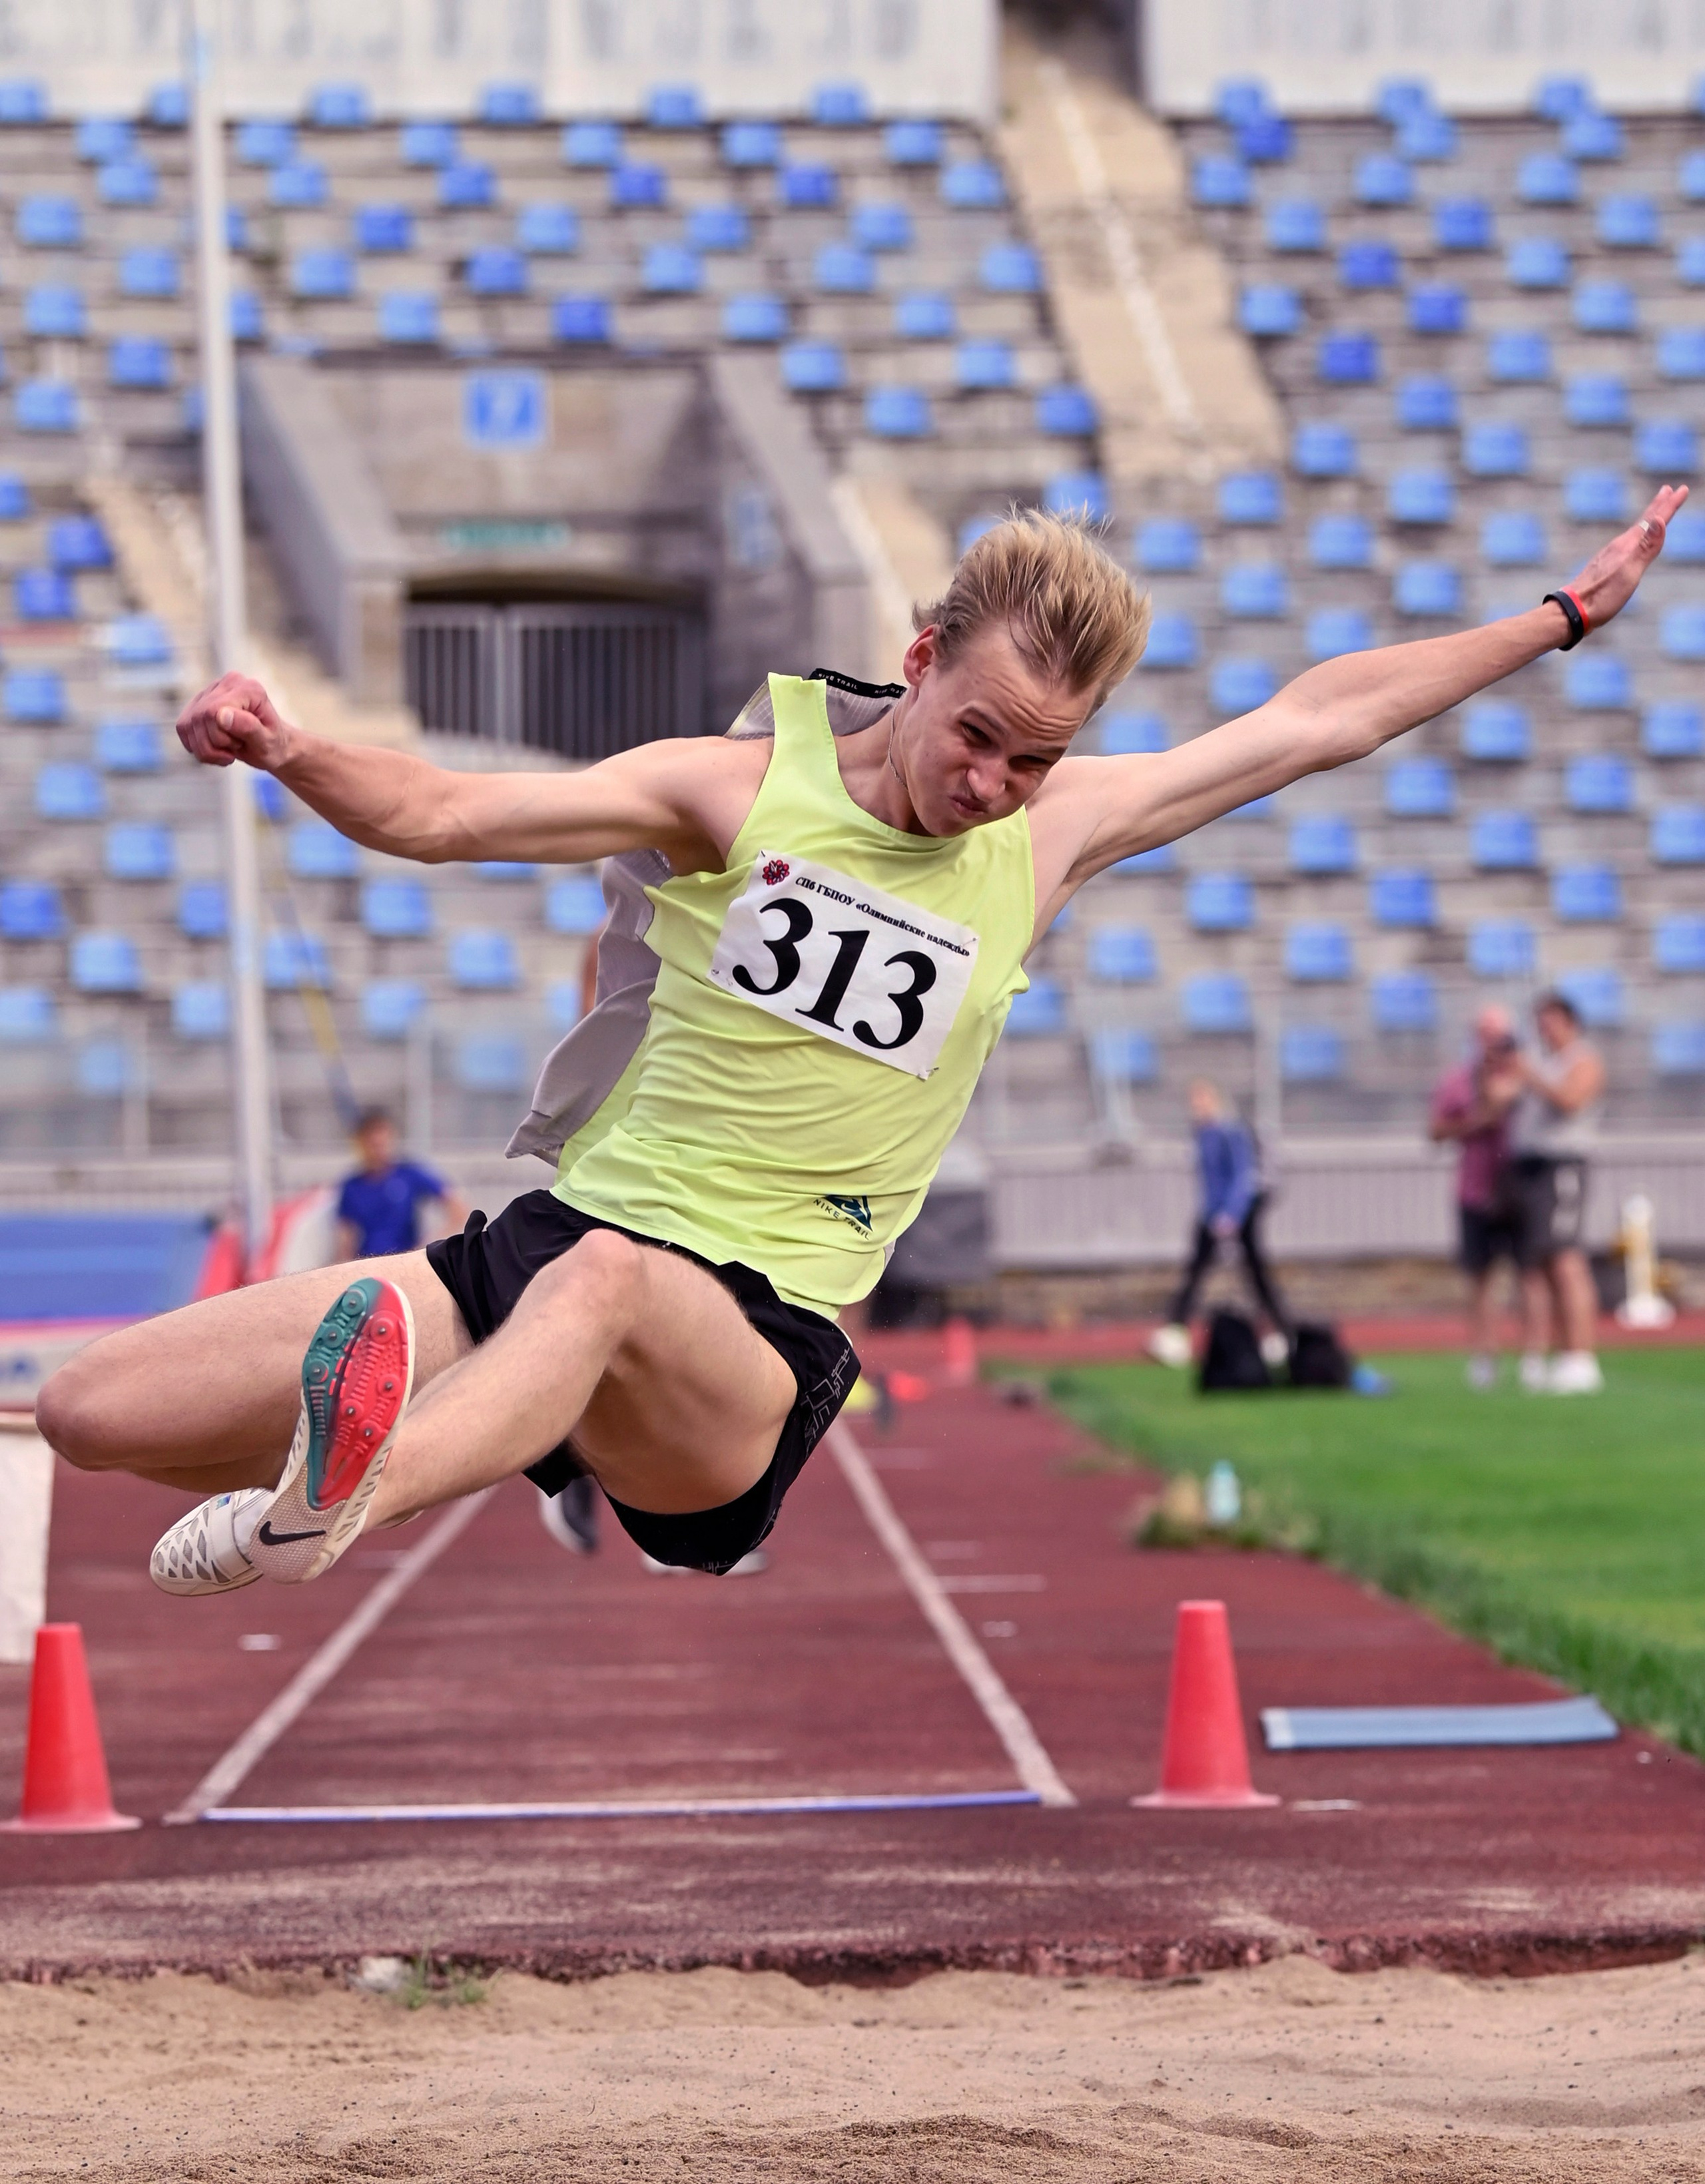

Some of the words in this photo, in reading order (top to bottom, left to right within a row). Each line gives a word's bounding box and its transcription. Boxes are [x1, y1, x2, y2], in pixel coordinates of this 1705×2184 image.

[837, 678, 858, 690] TRAIL
[795, 876, 817, 891] СПб
[815, 883, 855, 906] ГБПОУ
[855, 902, 926, 938] «Олимпийские
[926, 934, 970, 957] надежды»
[732, 898, 936, 1050] 313
[813, 1199, 841, 1219] NIKE
[843, 1217, 870, 1240] TRAIL
